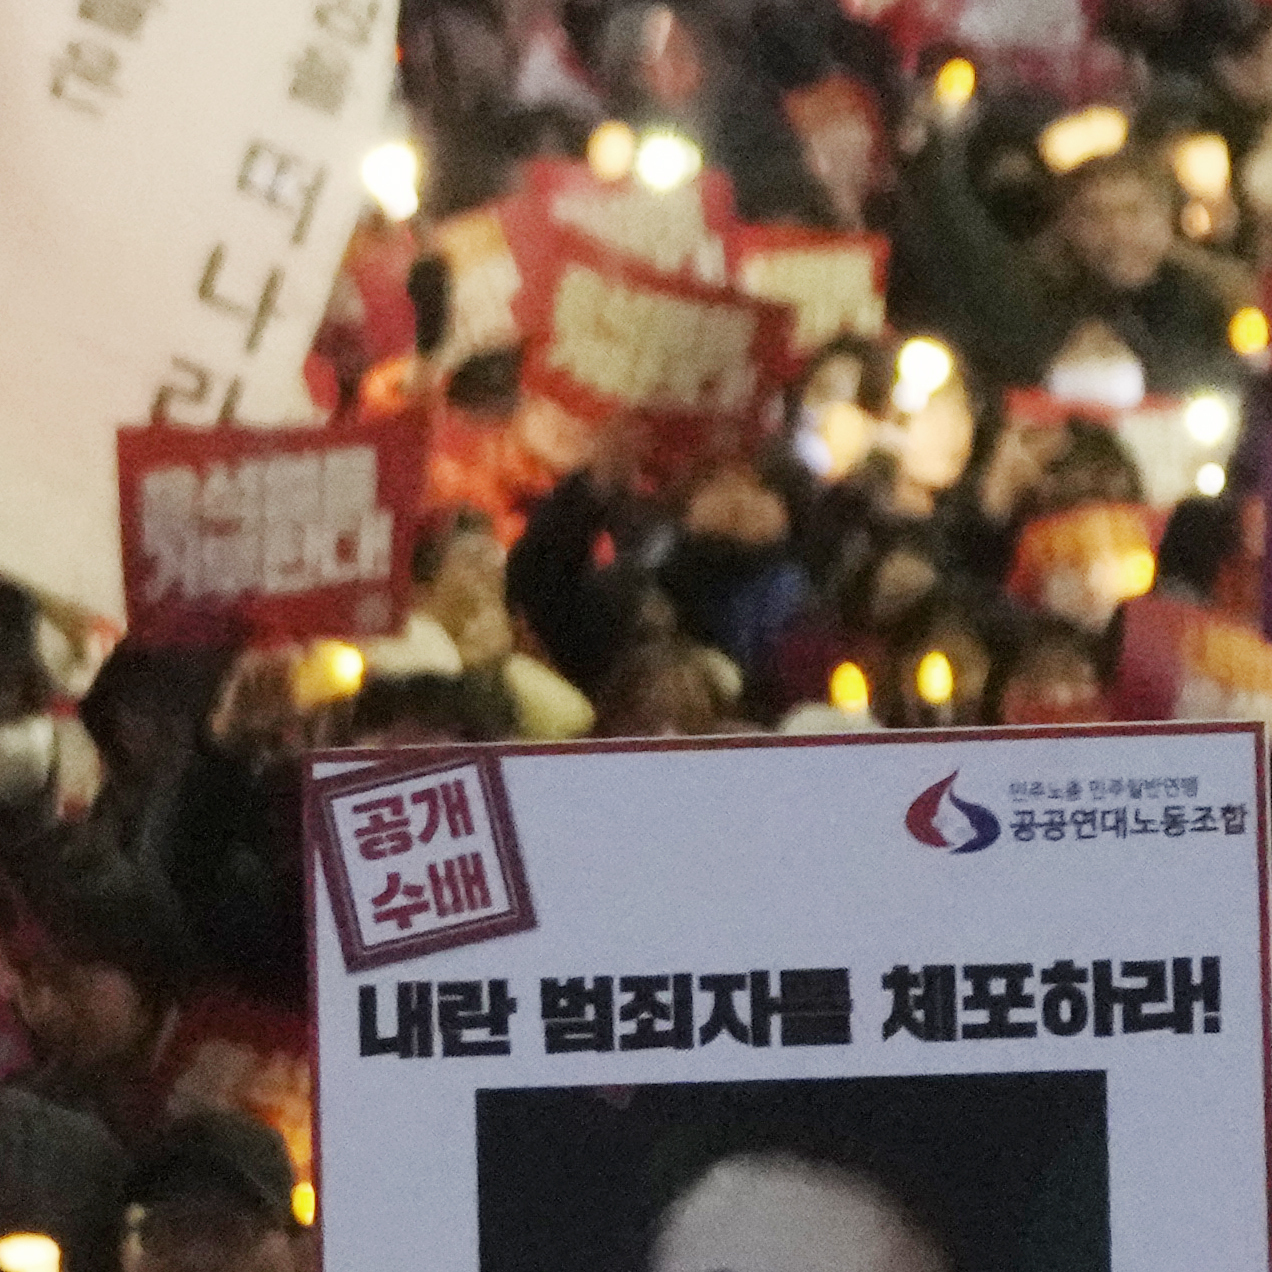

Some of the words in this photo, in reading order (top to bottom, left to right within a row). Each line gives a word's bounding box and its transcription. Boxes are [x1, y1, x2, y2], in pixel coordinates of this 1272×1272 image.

[353, 779, 475, 861] 공개
[1009, 803, 1248, 843] 공공연대노동조합
[372, 852, 492, 930] 수배
[358, 978, 517, 1060] 내란
[539, 966, 854, 1056] 범죄자를
[880, 955, 1222, 1043] 체포하라!
